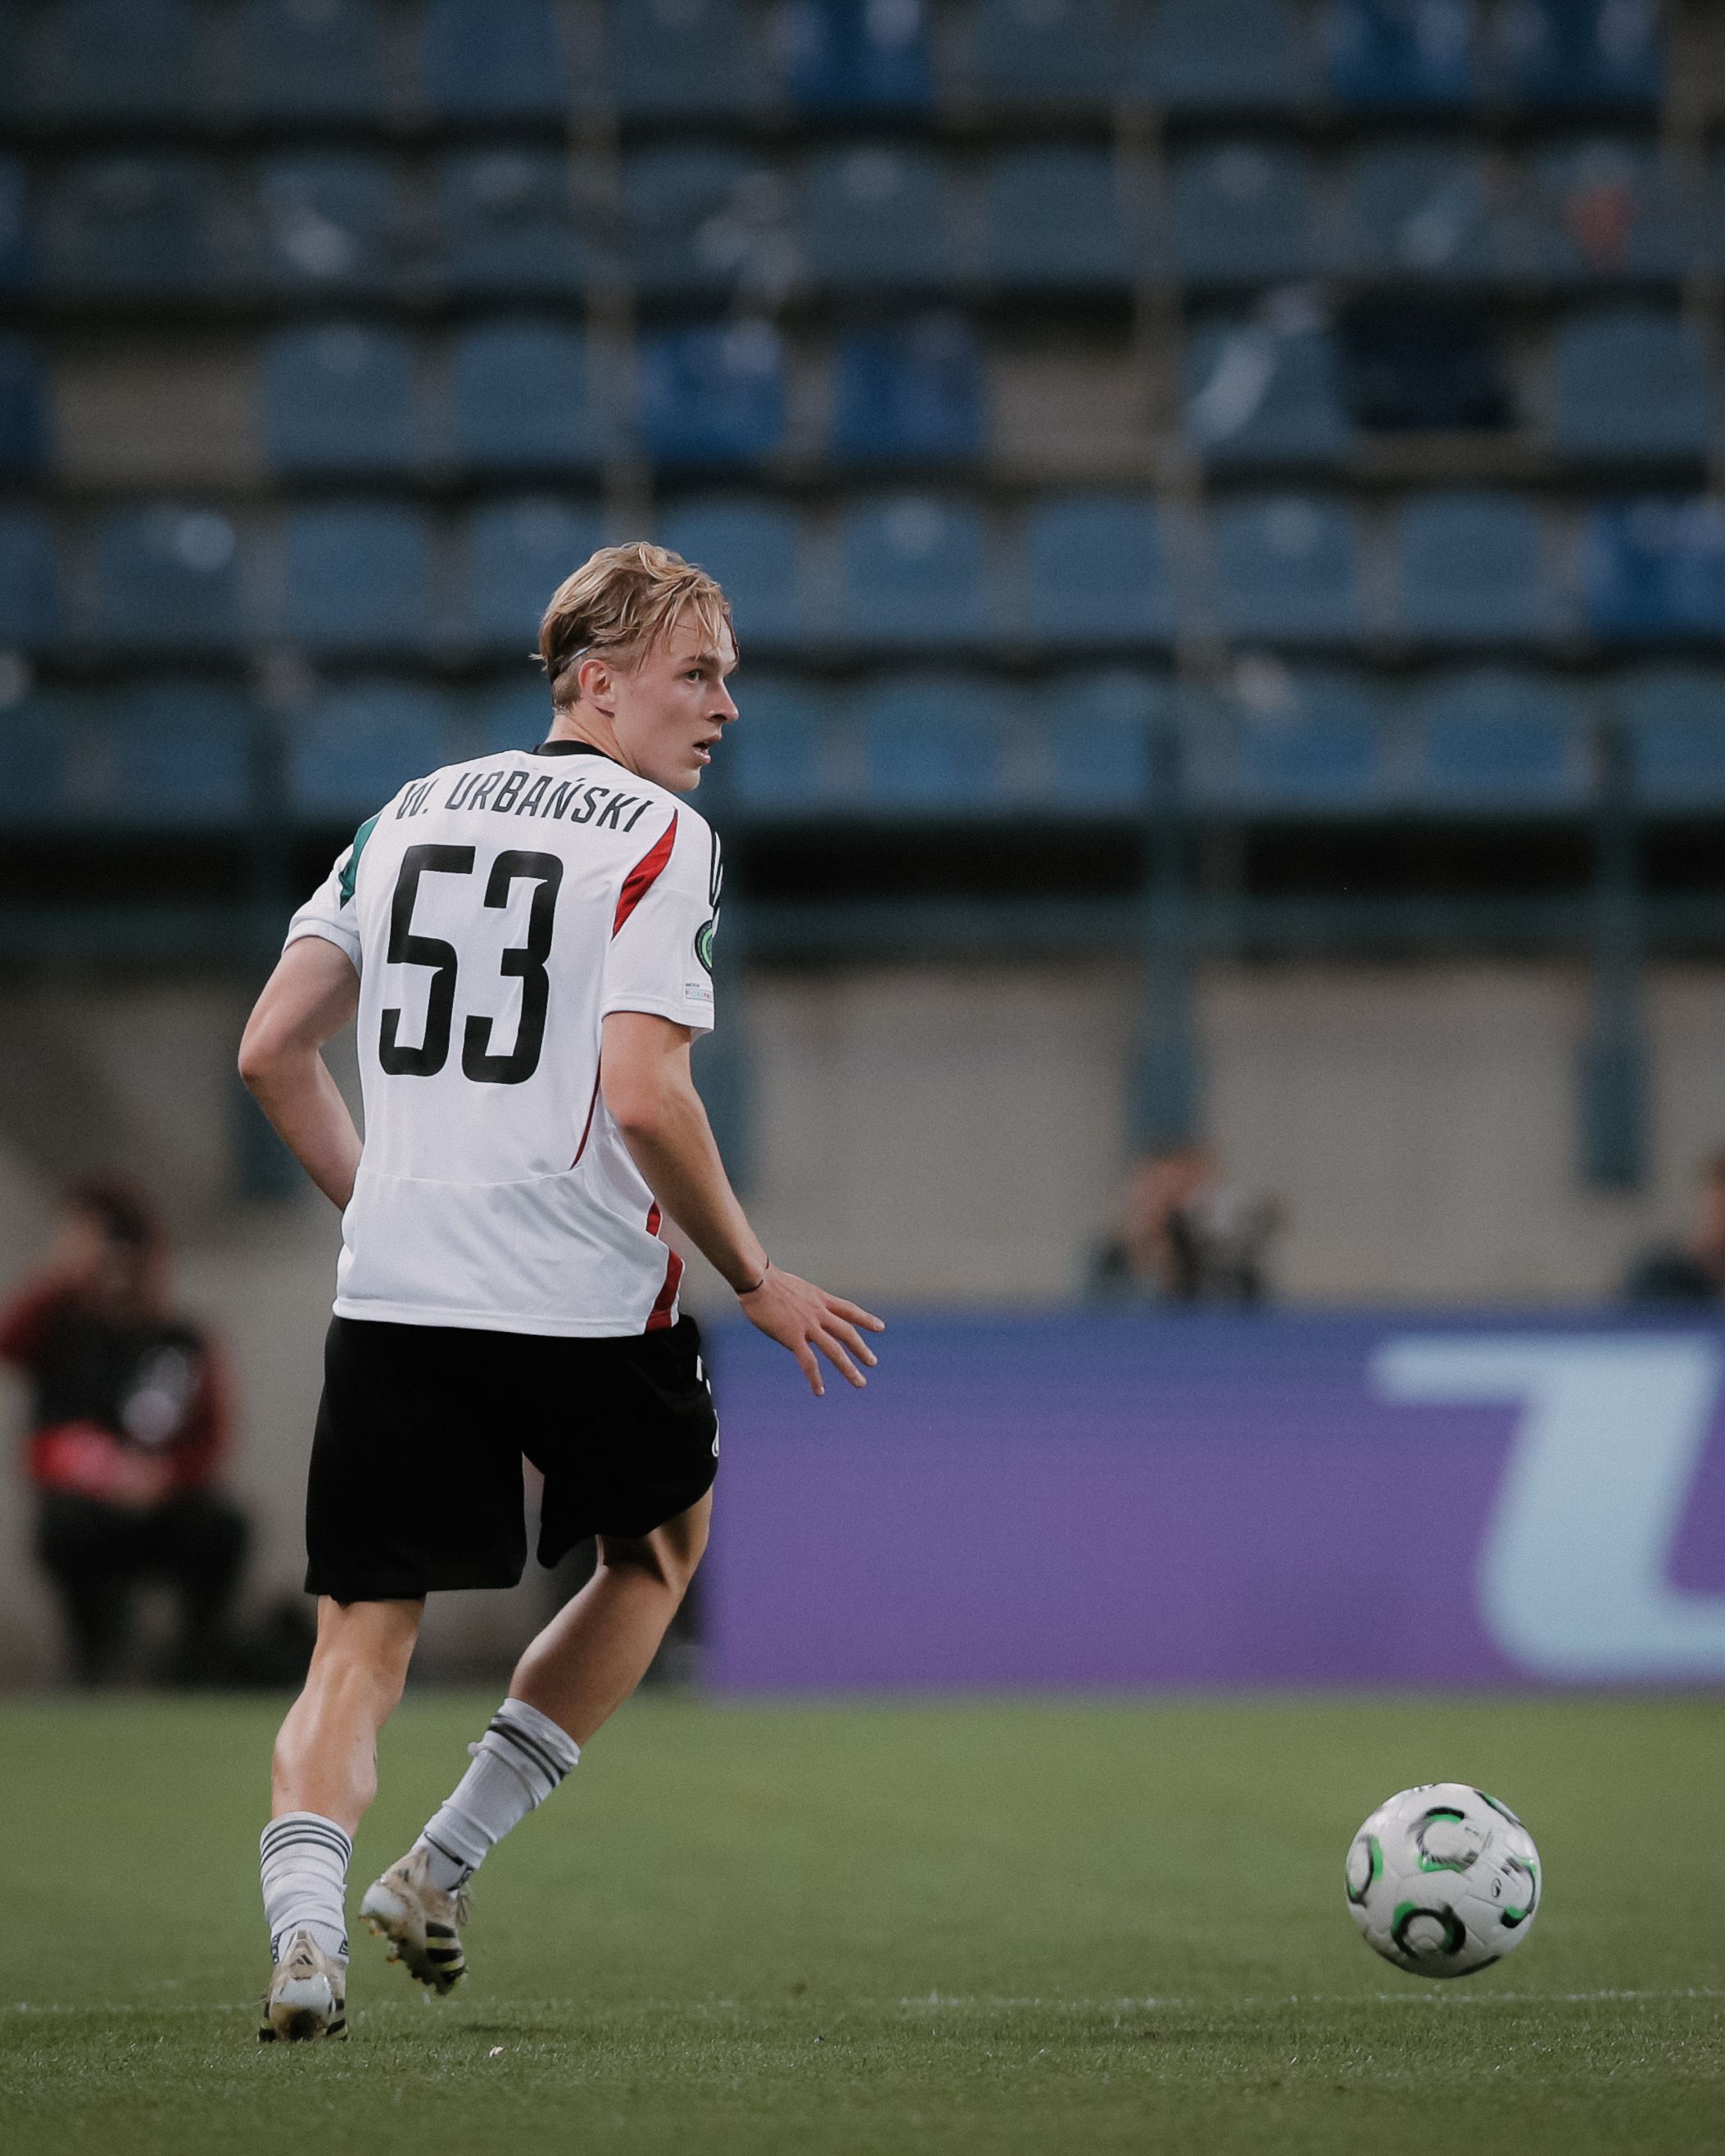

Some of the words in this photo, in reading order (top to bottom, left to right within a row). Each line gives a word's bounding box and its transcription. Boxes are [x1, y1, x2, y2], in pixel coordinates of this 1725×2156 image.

[396, 778, 439, 820] W.
[445, 770, 655, 833] URBAŃSKI
[378, 844, 564, 1085] 53
